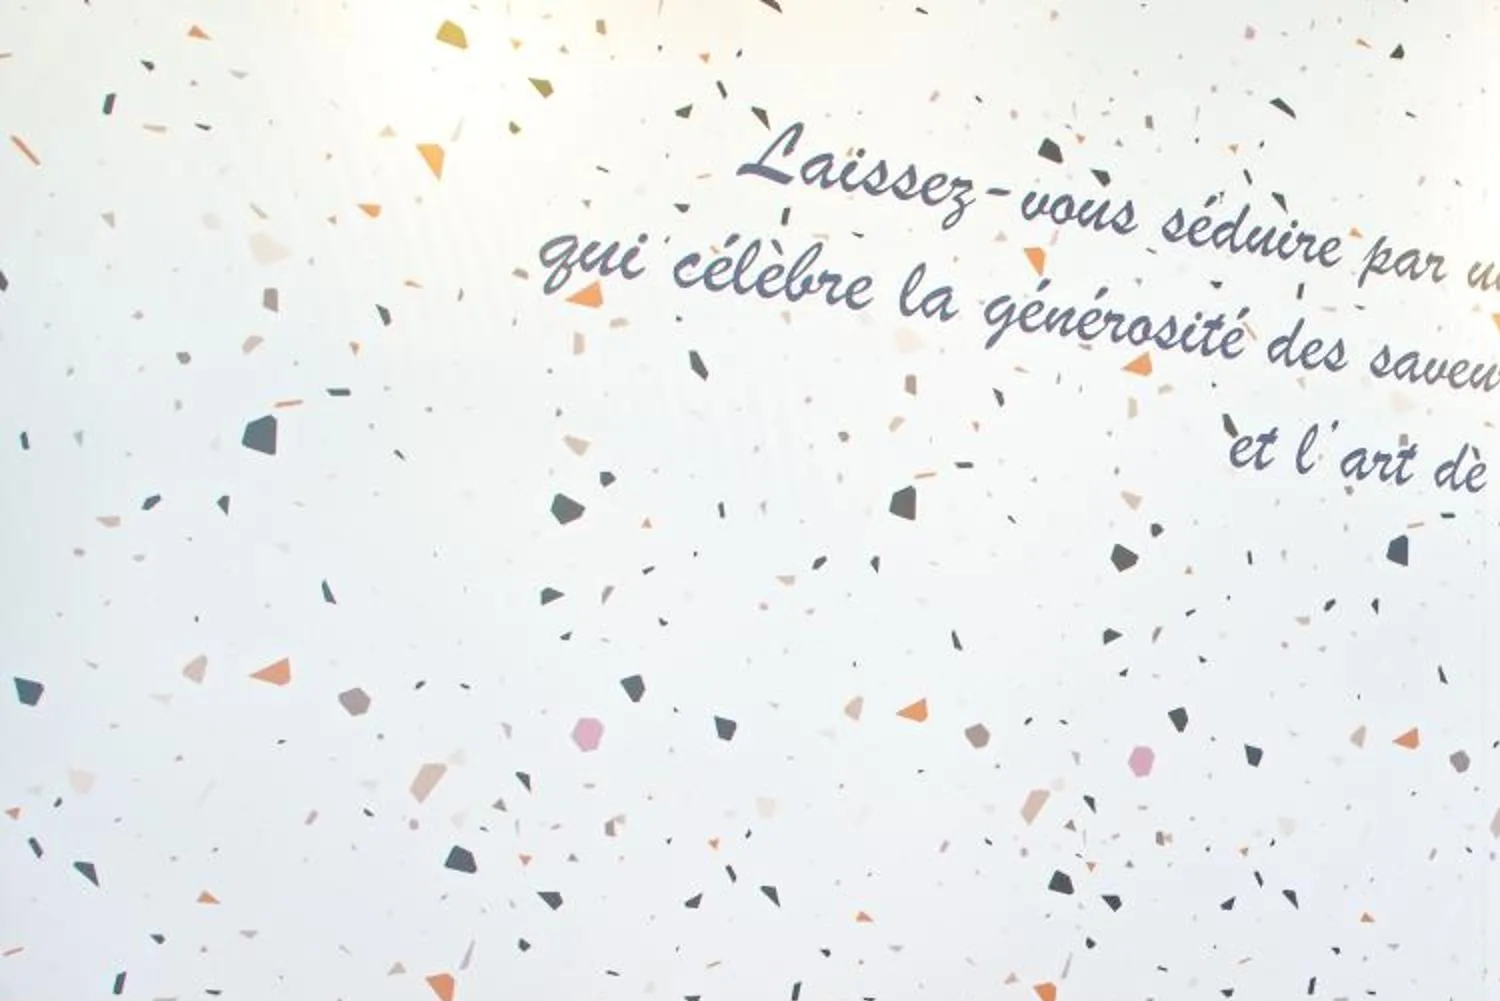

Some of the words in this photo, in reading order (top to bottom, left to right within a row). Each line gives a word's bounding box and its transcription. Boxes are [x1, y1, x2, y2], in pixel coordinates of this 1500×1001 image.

[736, 121, 1139, 235] Laissez-vous
[1161, 194, 1344, 268] séduire
[1357, 235, 1448, 289] par
[538, 232, 648, 296] qui
[673, 232, 875, 310] célèbre
[899, 262, 958, 322] la
[983, 277, 1251, 360] générosité
[1266, 316, 1349, 372] des
[1229, 426, 1279, 470] et
[1434, 442, 1488, 493] de
